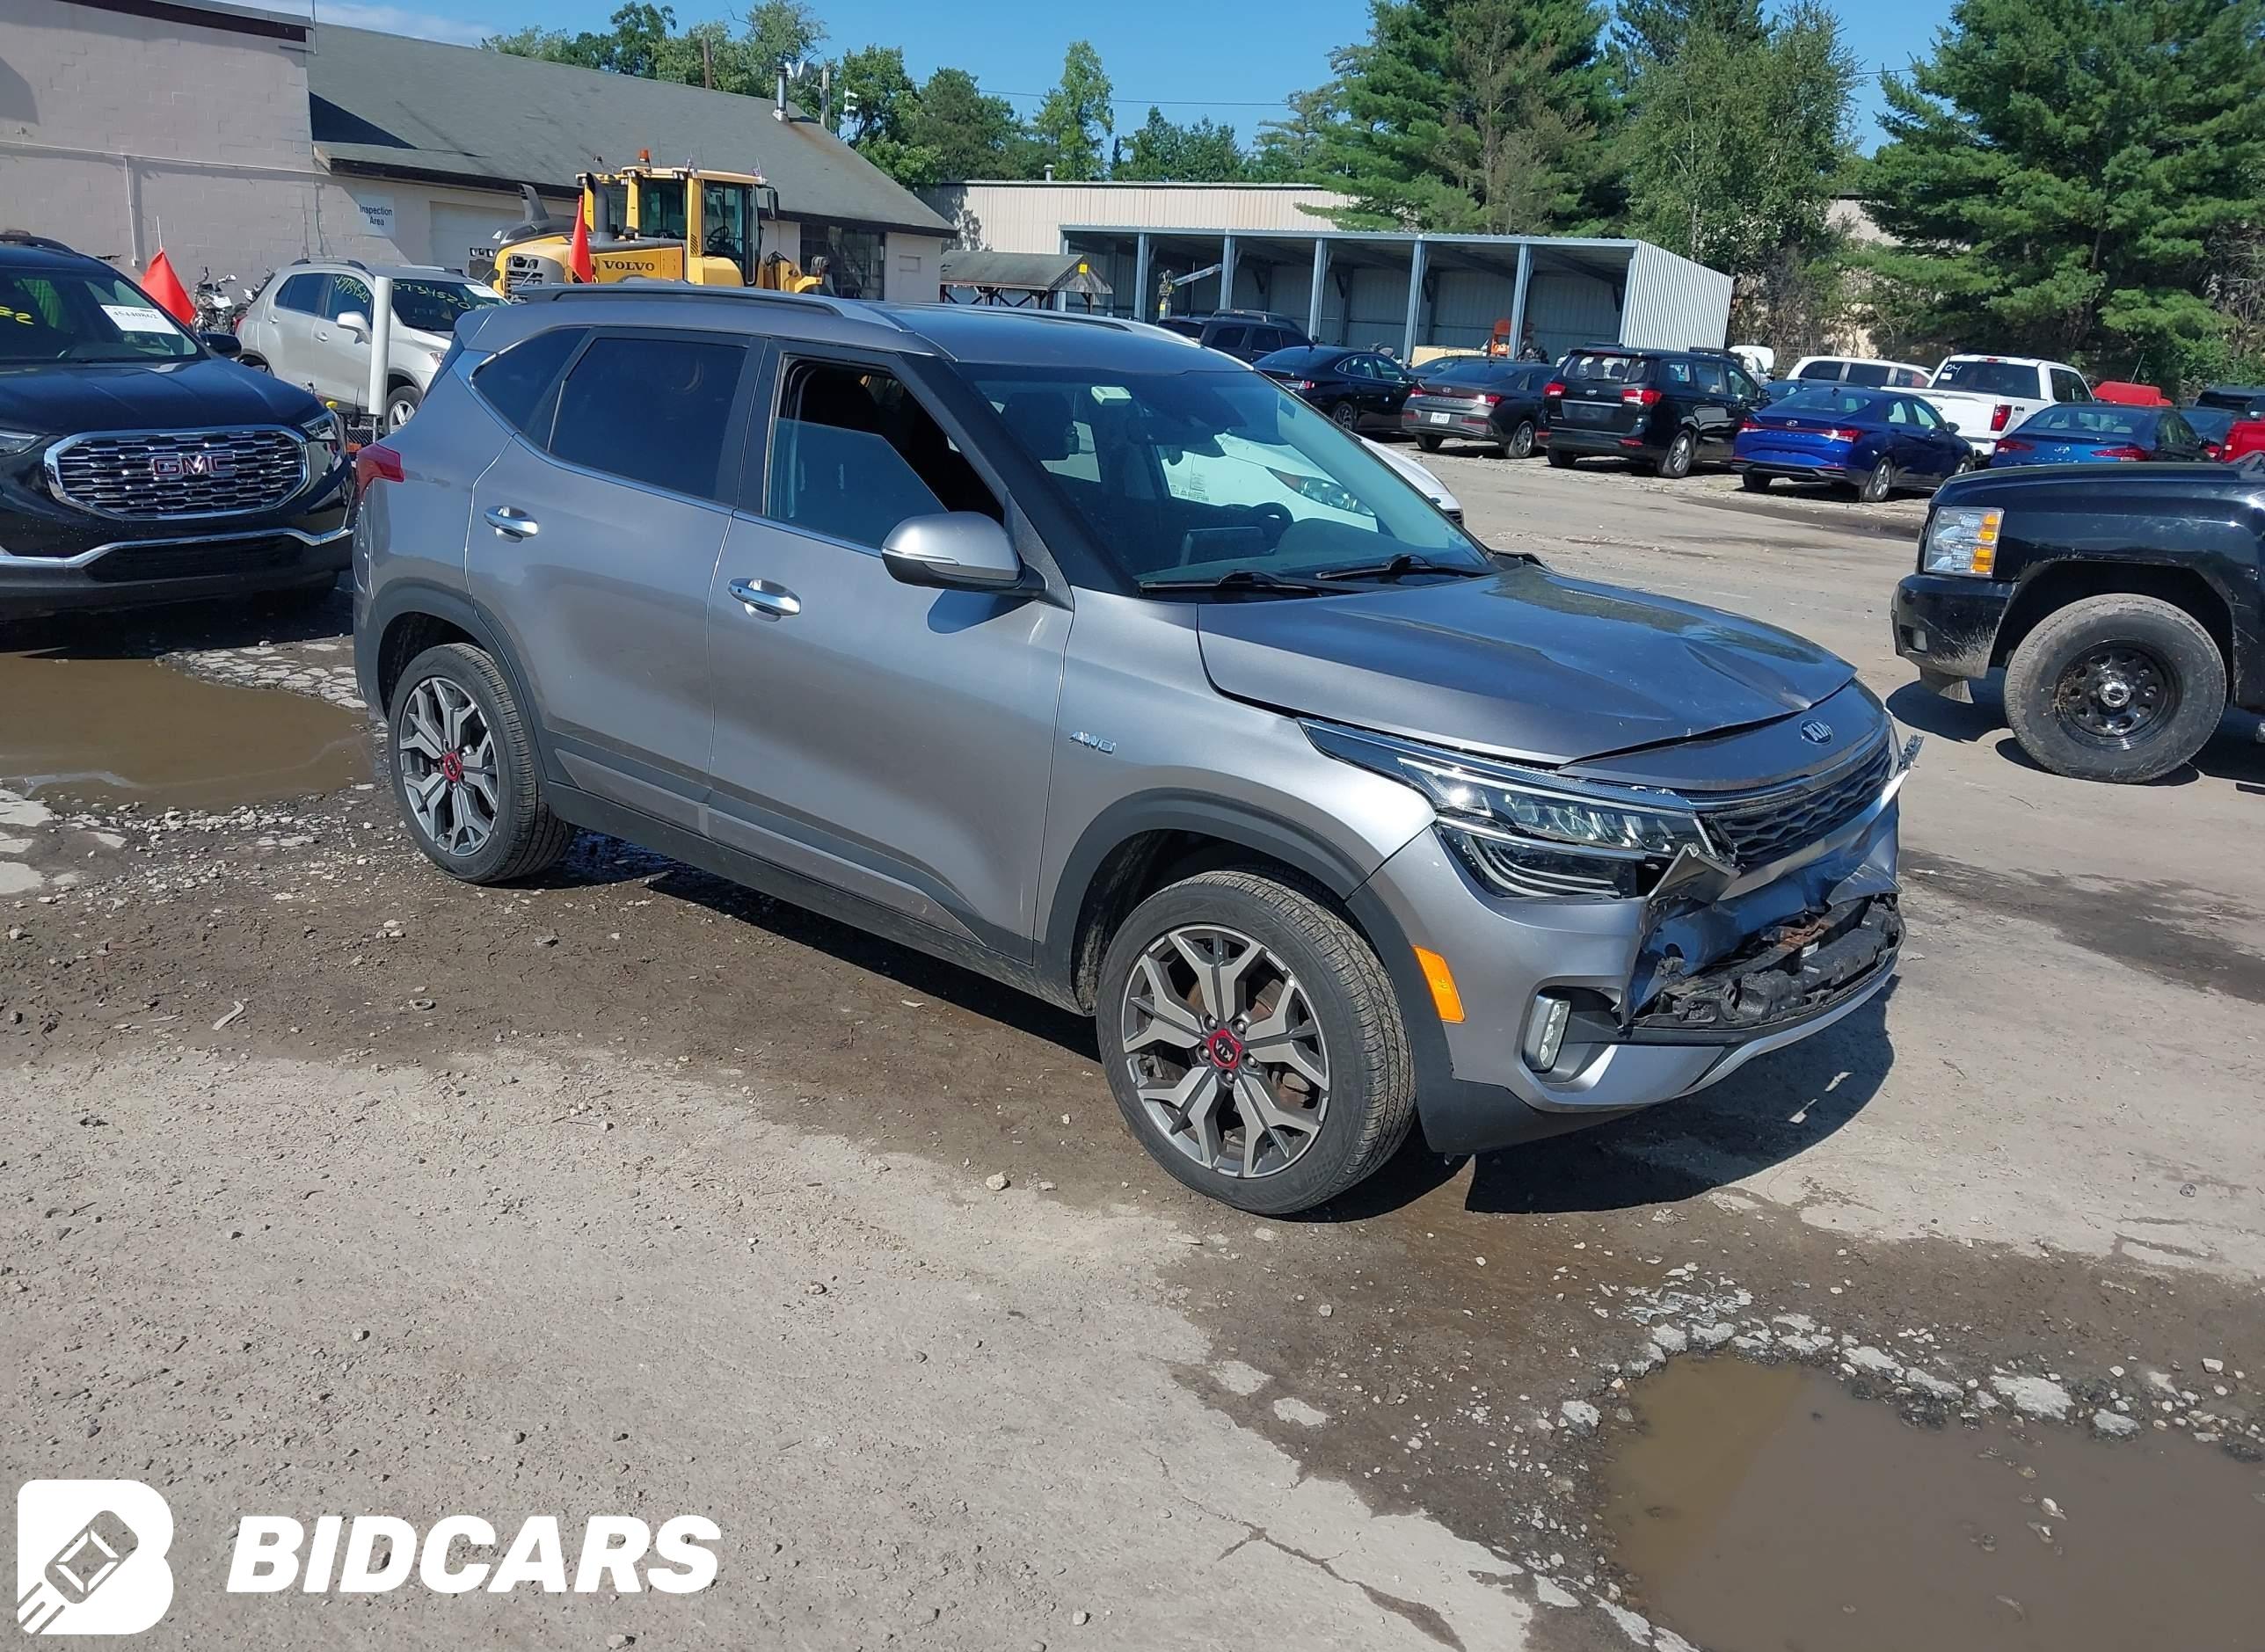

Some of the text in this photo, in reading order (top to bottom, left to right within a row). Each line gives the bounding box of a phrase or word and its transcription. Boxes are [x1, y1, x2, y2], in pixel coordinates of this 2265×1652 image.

[359, 203, 393, 216] Inspection
[369, 215, 385, 226] Area
[602, 260, 655, 272] VOLVO
[151, 451, 237, 477] GMC
[1803, 721, 1832, 741] KIA
[1215, 1039, 1234, 1061] KIA
